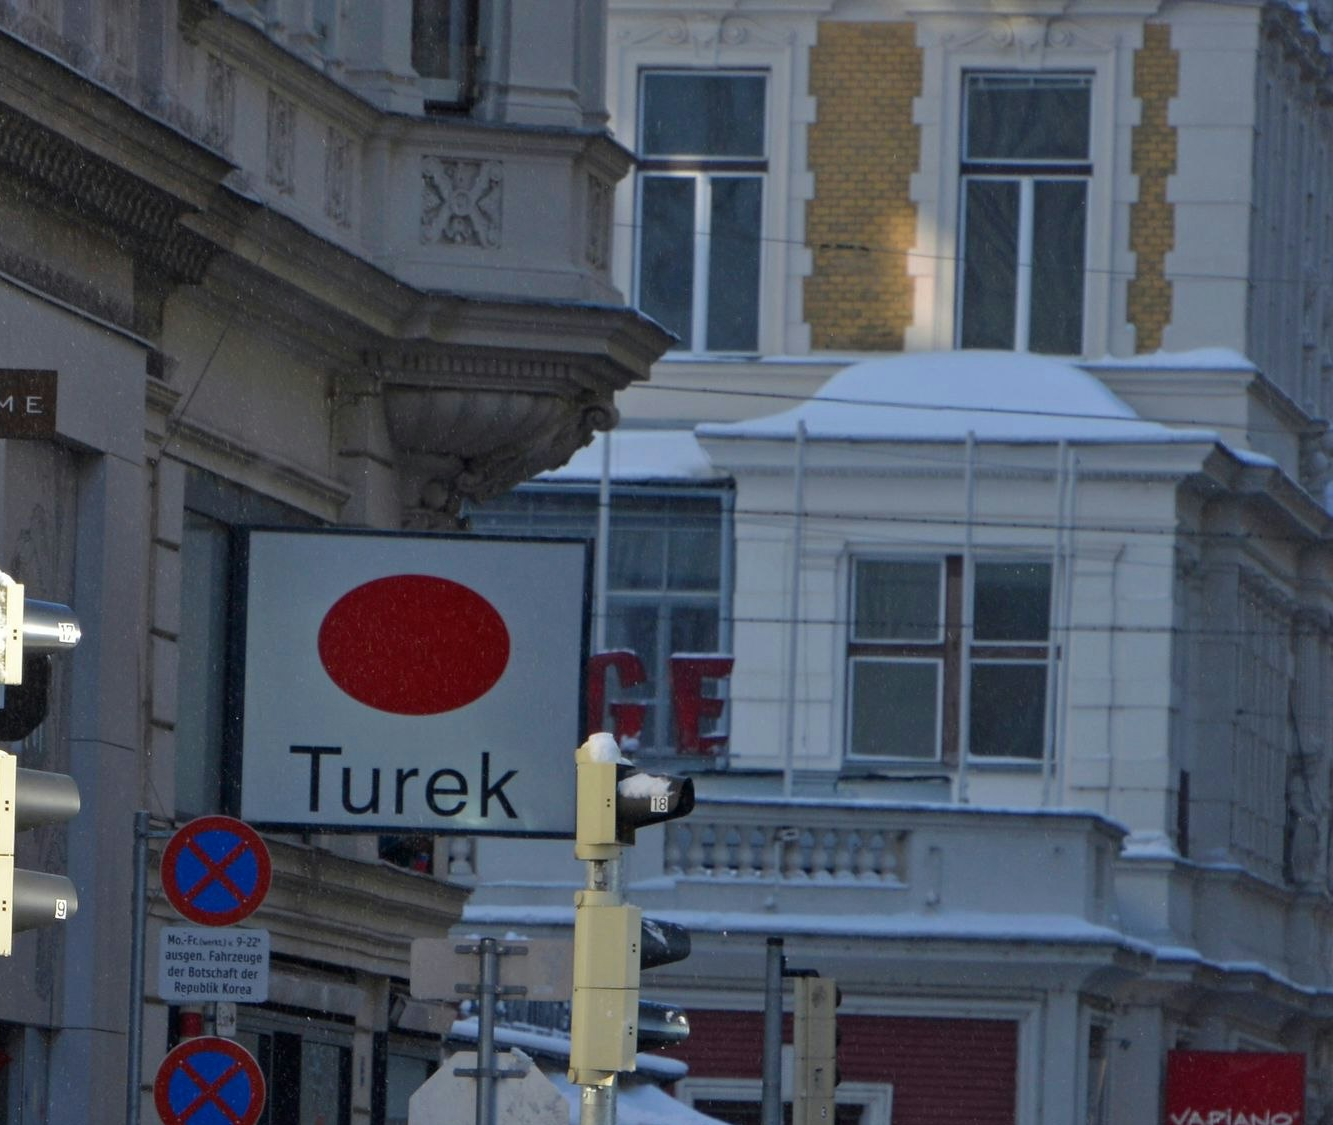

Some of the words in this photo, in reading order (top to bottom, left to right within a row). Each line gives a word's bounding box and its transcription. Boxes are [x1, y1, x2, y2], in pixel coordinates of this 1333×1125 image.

[290, 744, 520, 819] Turek
[653, 797, 667, 812] 18
[57, 901, 66, 917] 9
[165, 951, 206, 963] ausgen.
[209, 950, 263, 965] Fahrzeuge
[167, 966, 184, 977] der
[188, 966, 238, 980] Botschaft
[241, 968, 259, 980] der
[174, 981, 219, 995] Republik
[222, 983, 252, 995] Korea
